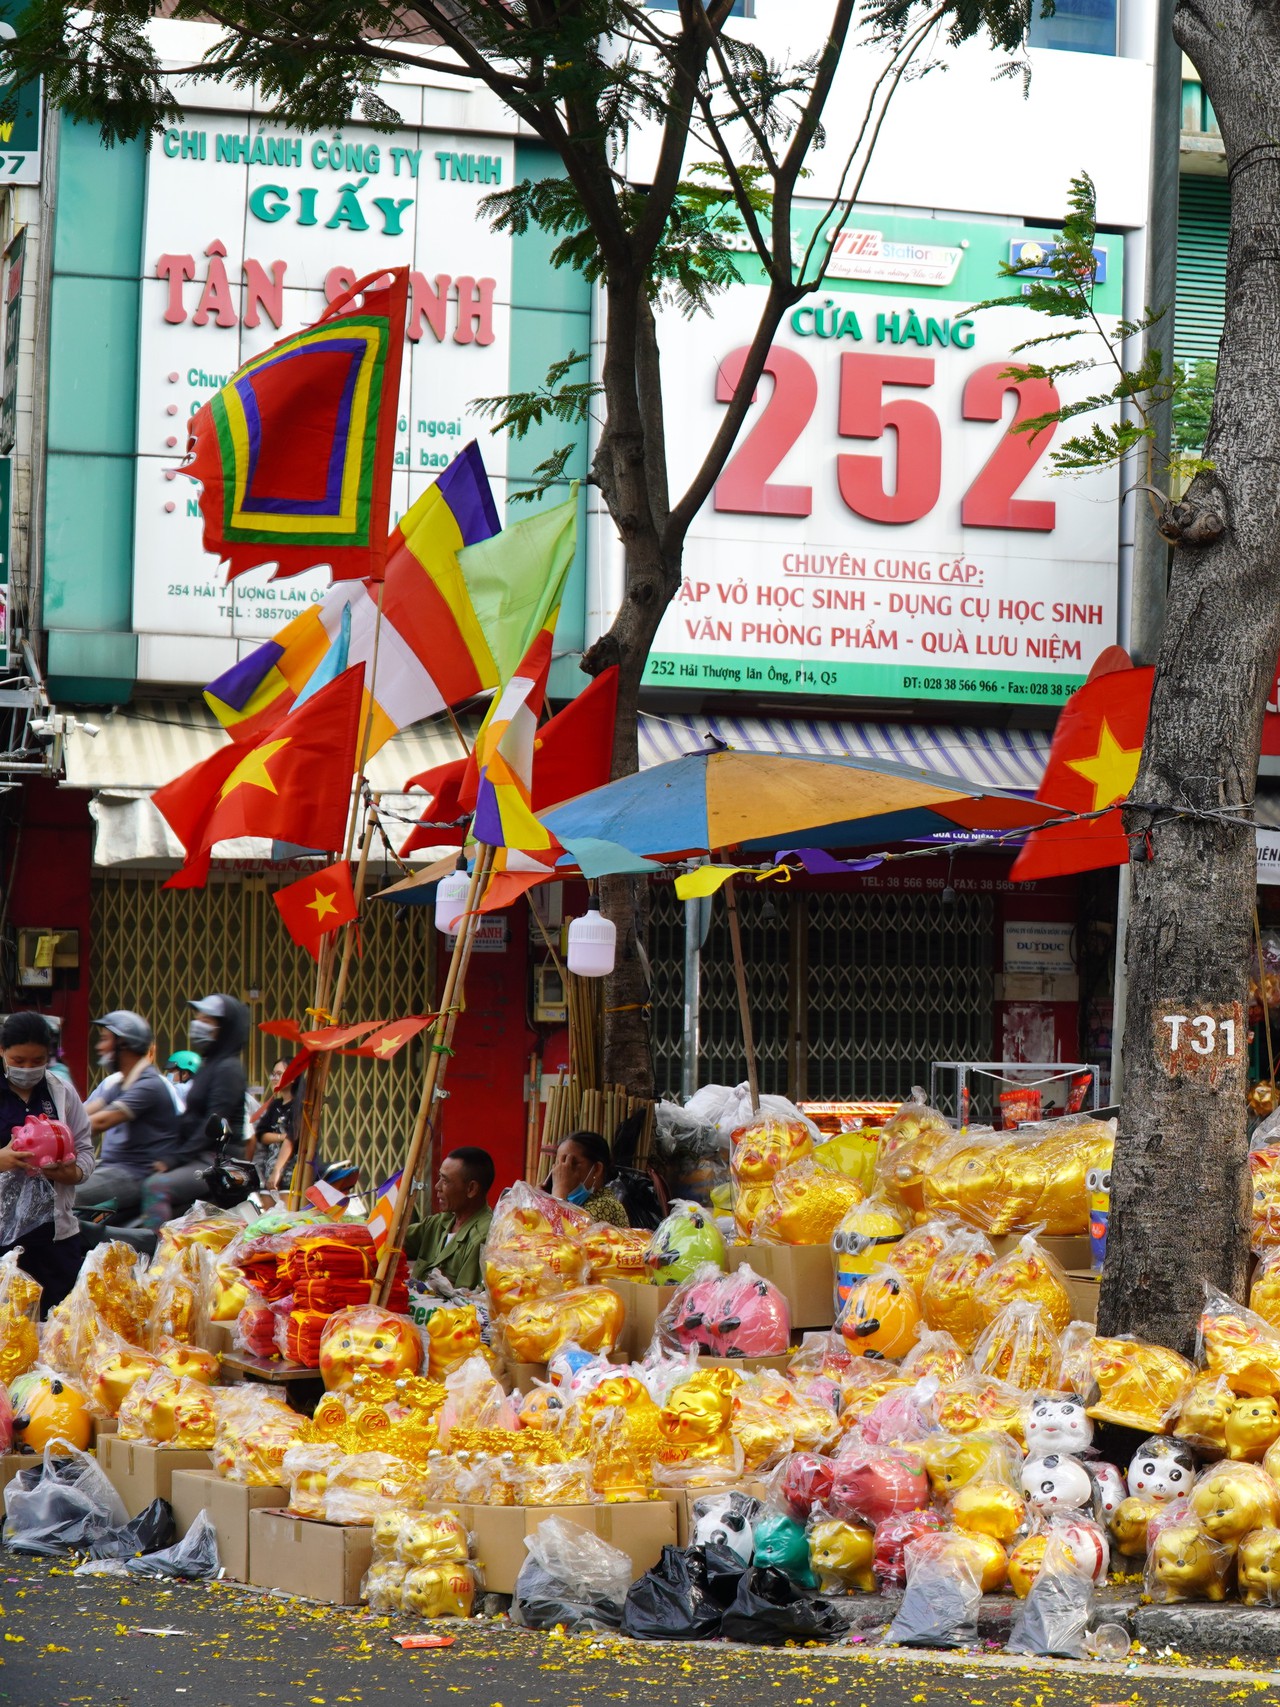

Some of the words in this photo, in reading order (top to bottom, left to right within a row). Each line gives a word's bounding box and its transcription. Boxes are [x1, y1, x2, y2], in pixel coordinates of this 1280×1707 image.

[163, 128, 207, 160] CHI
[216, 127, 302, 168] NHÁNH
[311, 134, 380, 174] CÔNG
[390, 147, 423, 178] TY
[435, 151, 502, 184] TNHH
[248, 177, 414, 235] GIẤY
[156, 239, 288, 328] TÂN
[324, 266, 497, 346] SNH
[790, 300, 863, 341] CỬA
[876, 308, 976, 349] HÀNG
[417, 417, 462, 440] ngoại
[714, 344, 1061, 533] 252
[419, 448, 450, 468] bao
[783, 552, 867, 577] CHUYÊN
[873, 558, 931, 581] CUNG
[938, 556, 985, 584] CẤP:
[167, 584, 190, 597] 254
[193, 582, 216, 598] HẢI
[671, 576, 711, 606] ẬP
[716, 577, 748, 605] VỞ
[756, 585, 805, 612] HỌC
[812, 588, 866, 611] SINH
[888, 592, 952, 619] DỤNG
[959, 597, 990, 623] CỤ
[998, 600, 1045, 626] HỌC
[1052, 602, 1104, 625] SINH
[218, 606, 243, 618] TEL
[684, 616, 732, 642] VĂN
[741, 619, 822, 646] PHÒNG
[831, 619, 898, 650] PHẨM
[921, 628, 969, 655] QUÀ
[975, 634, 1019, 657] LƯU
[1026, 632, 1082, 664] NIỆM
[651, 661, 675, 676] 252
[679, 663, 698, 677] Hải
[702, 665, 741, 682] Thượng
[746, 667, 762, 680] lãn
[767, 665, 792, 684] Ông,
[820, 671, 838, 684] Q5
[903, 677, 921, 689] ĐT:
[923, 679, 942, 690] 028
[944, 679, 957, 691] 38
[958, 680, 977, 691] 566
[979, 680, 998, 692] 966
[1008, 682, 1029, 694] Fax:
[1030, 683, 1049, 695] 028
[1051, 684, 1063, 695] 38
[861, 877, 884, 887] TEL:
[887, 877, 900, 887] 38
[903, 878, 922, 888] 566
[926, 878, 945, 888] 966
[954, 879, 977, 889] FAX:
[980, 879, 993, 890] 38
[1019, 881, 1038, 891] 797
[1162, 1014, 1236, 1057] T31
